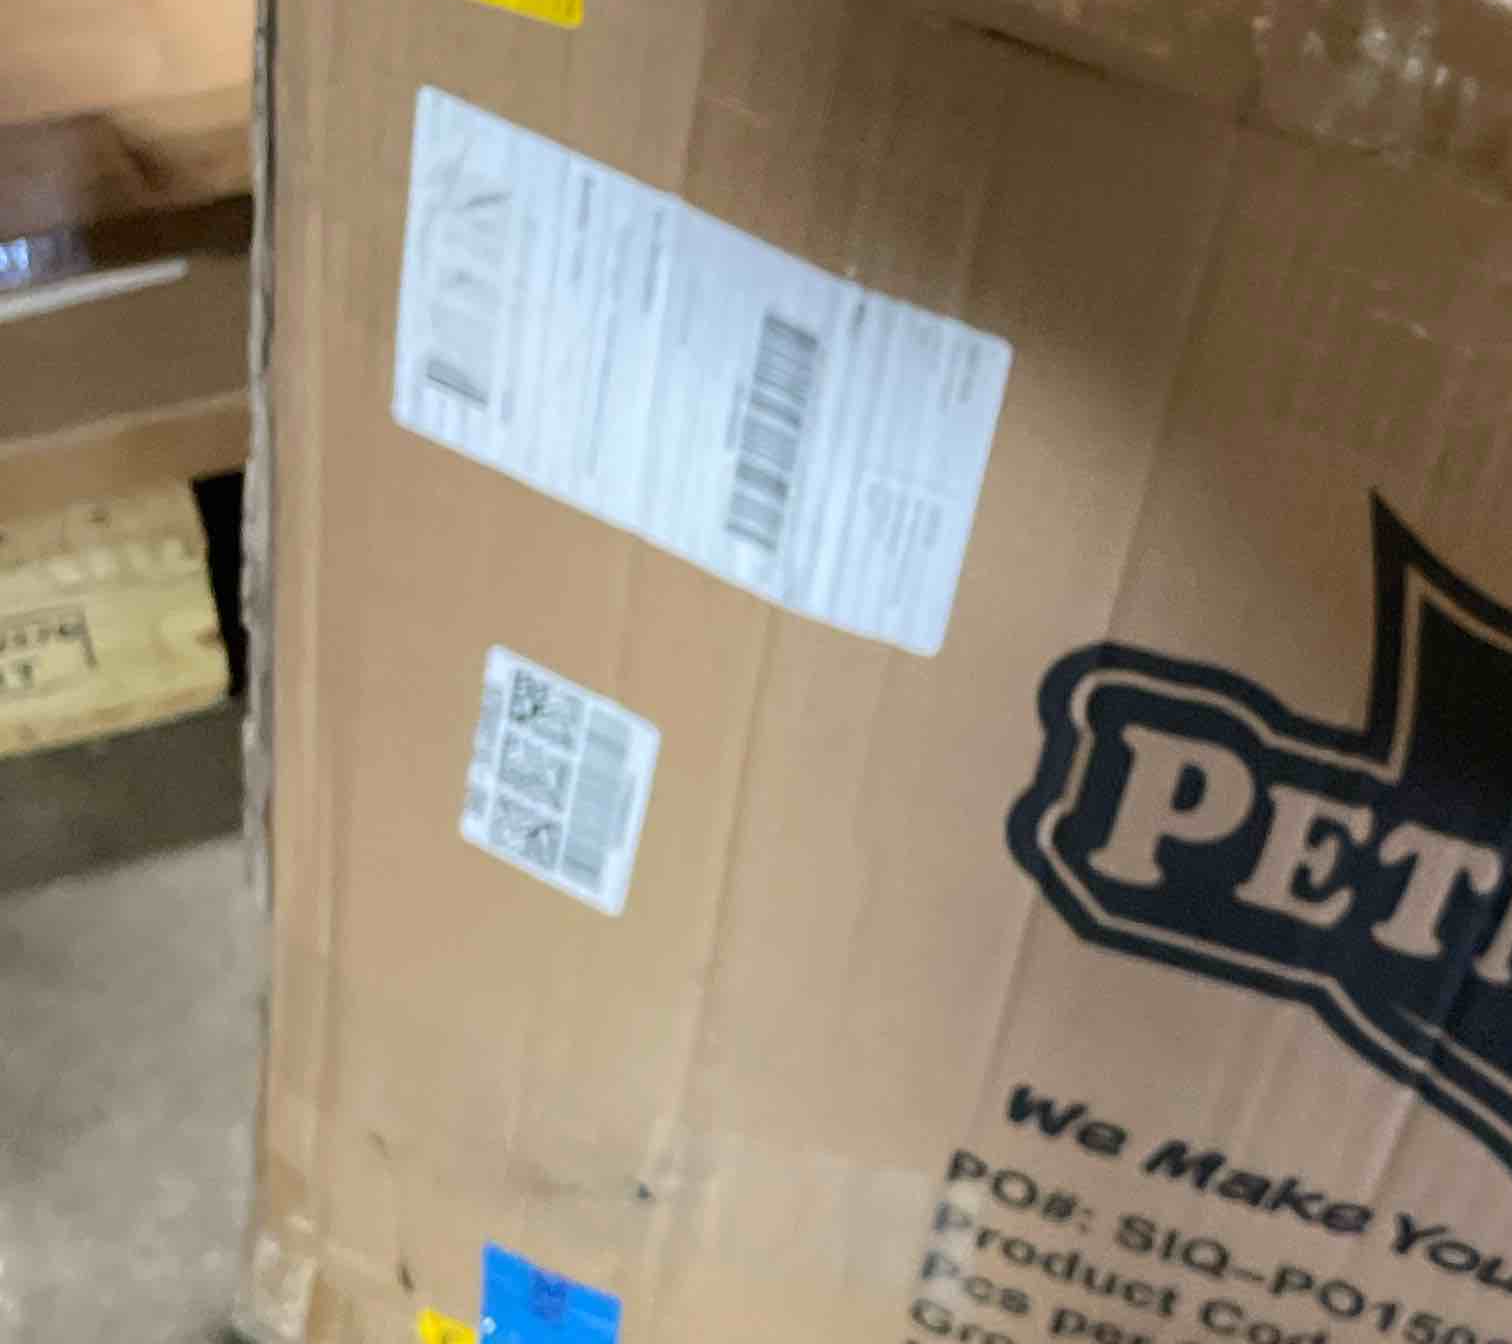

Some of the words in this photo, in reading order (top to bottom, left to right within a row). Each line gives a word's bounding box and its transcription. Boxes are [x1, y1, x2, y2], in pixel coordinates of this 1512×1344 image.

[947, 1150, 1094, 1234] PO#:
[1006, 1084, 1129, 1156] We
[1141, 1140, 1374, 1234] Make
[922, 1249, 1033, 1317] Pcs
[932, 1201, 1178, 1319] Product
